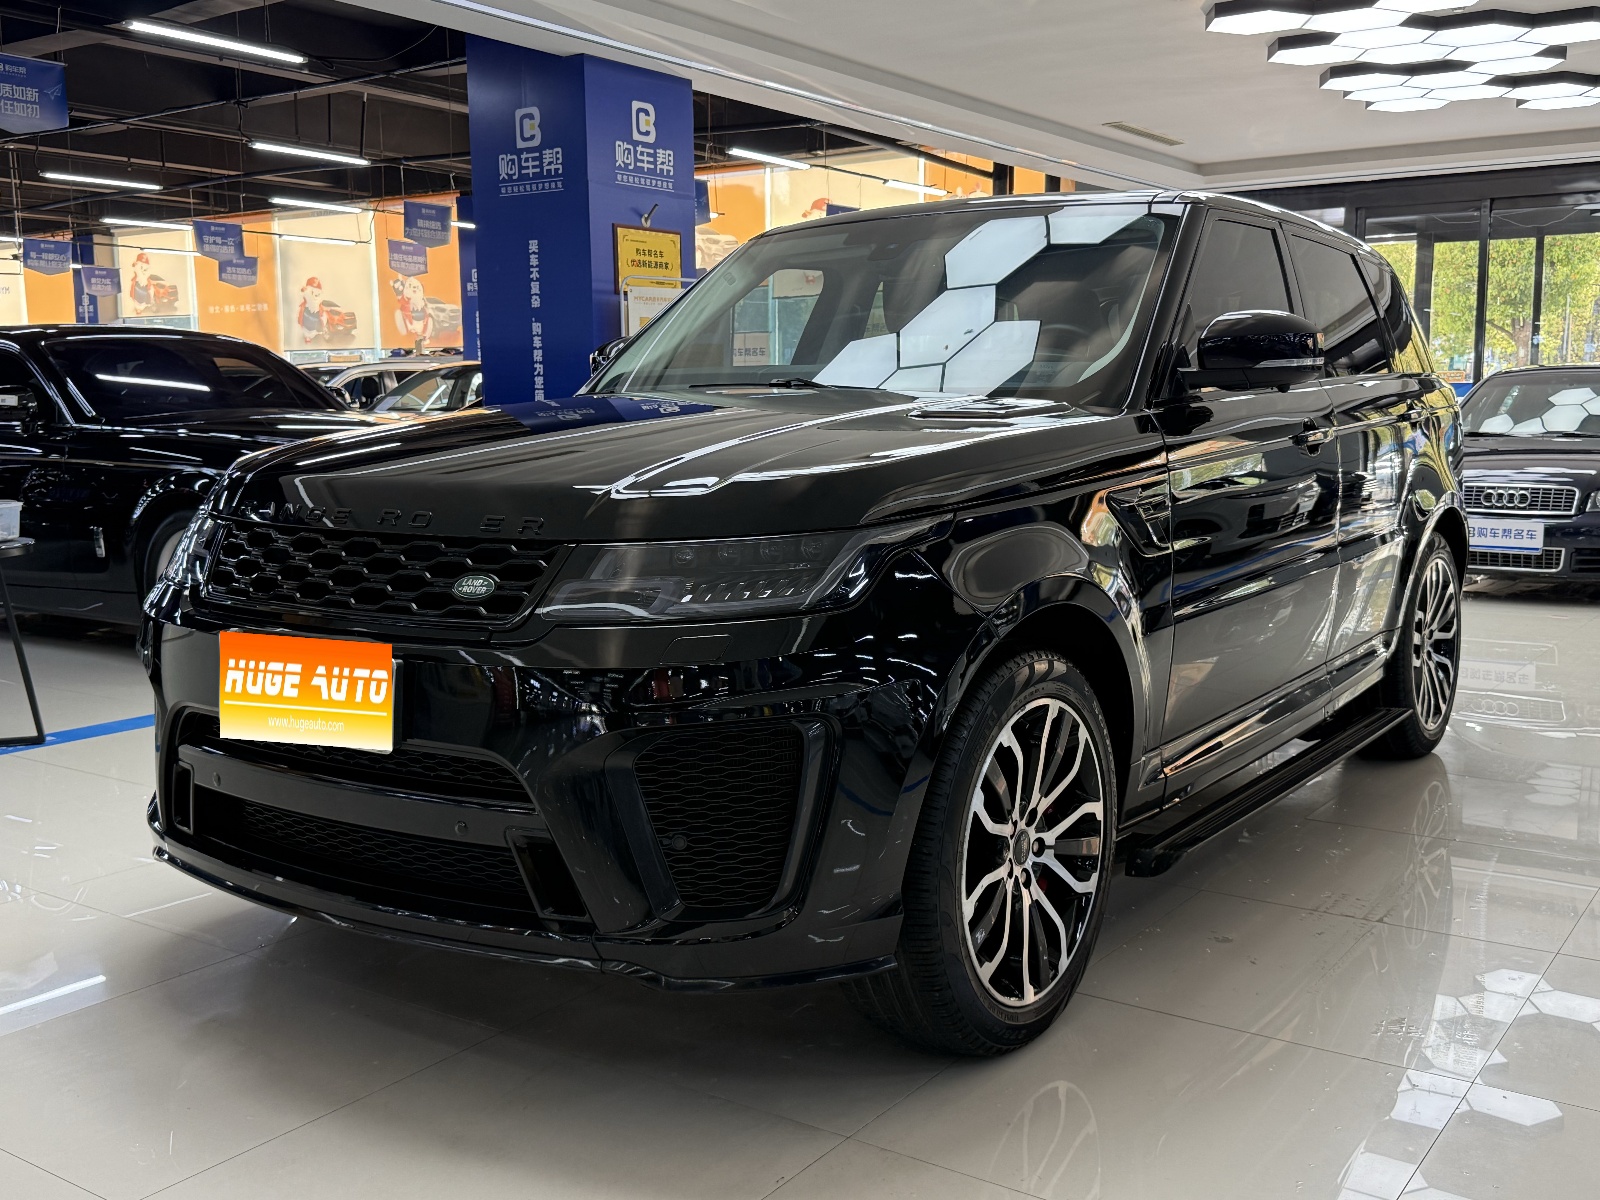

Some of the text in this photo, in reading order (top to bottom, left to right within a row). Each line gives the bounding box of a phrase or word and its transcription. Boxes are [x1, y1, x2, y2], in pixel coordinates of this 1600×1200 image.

[499, 147, 562, 180] 购车帮
[615, 140, 674, 175] 购车帮
[636, 248, 664, 258] 购车帮名车
[1476, 527, 1537, 540] 购车帮名车
[462, 586, 487, 594] ROVER
